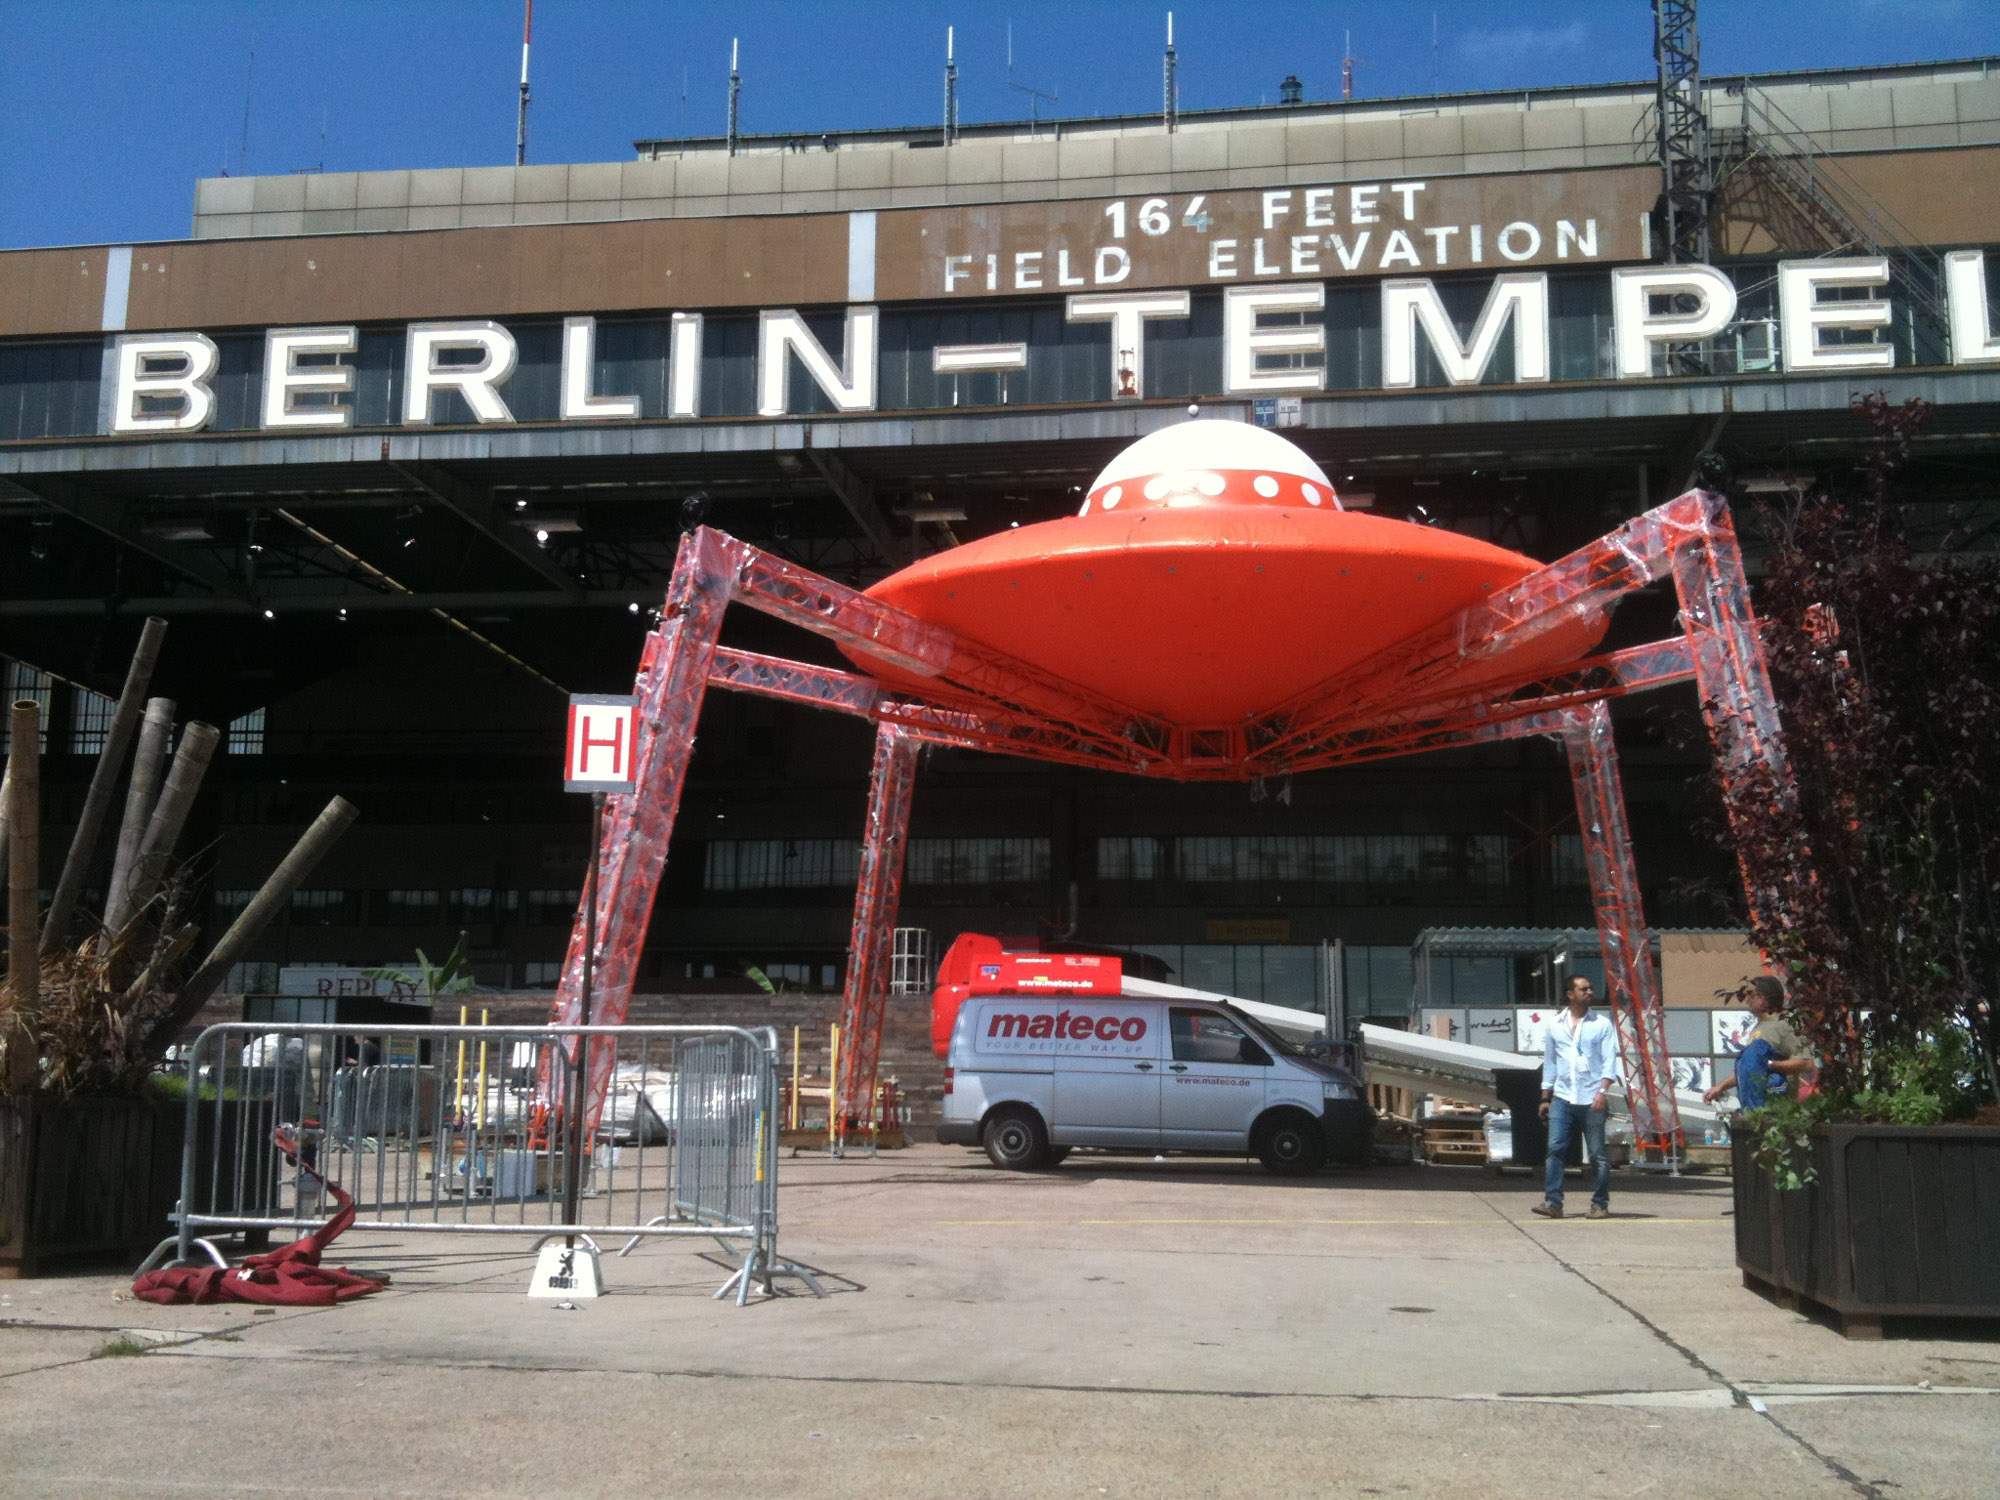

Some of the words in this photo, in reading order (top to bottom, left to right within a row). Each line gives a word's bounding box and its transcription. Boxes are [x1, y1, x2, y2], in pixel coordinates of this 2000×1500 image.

[1104, 195, 1215, 239] 164
[1261, 182, 1426, 230] FEET
[943, 245, 1132, 293] FIELD
[1208, 217, 1598, 279] ELEVATION
[580, 715, 625, 774] H
[985, 1042, 1022, 1050] YOUR
[1028, 1043, 1082, 1051] BETTER
[1090, 1044, 1118, 1052] WAY
[986, 1009, 1148, 1042] mateco
[1175, 1076, 1251, 1087] www.mateco.de
